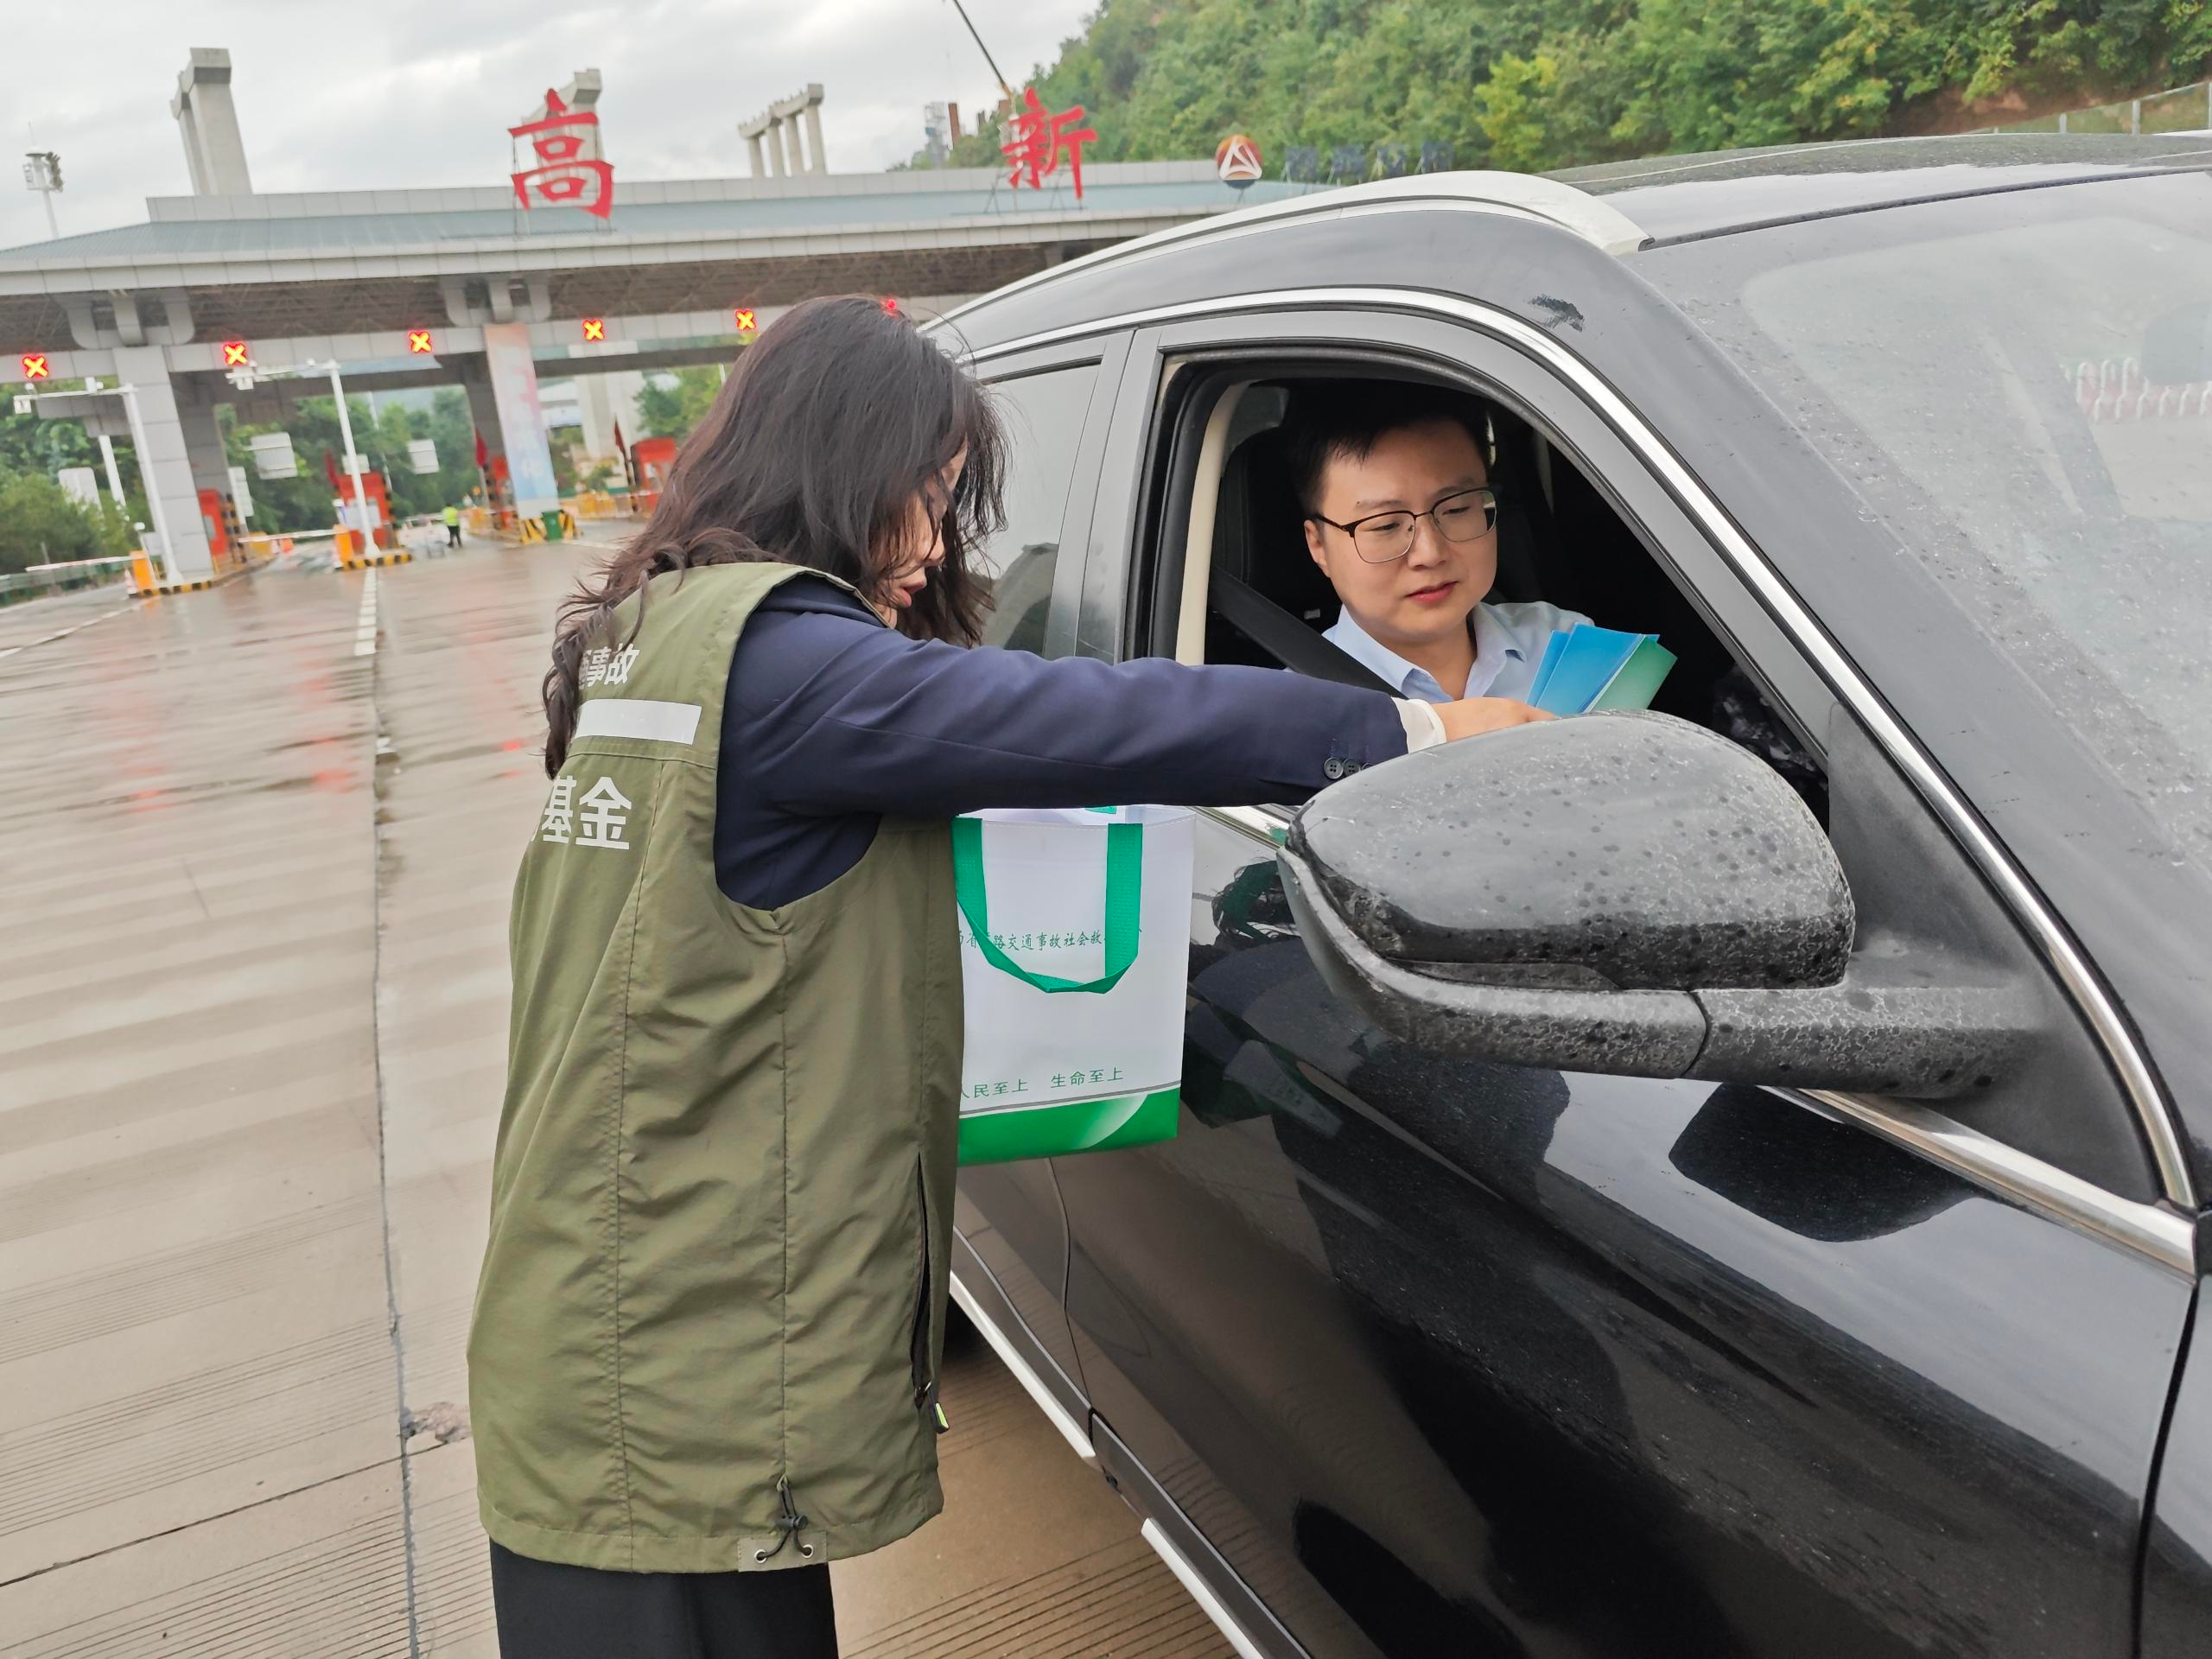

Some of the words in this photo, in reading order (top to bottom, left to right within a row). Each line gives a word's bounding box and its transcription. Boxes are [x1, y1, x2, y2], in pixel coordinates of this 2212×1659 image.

[507, 88, 614, 219] 高
[1001, 87, 1098, 200] 新
[531, 774, 632, 849] 基金
[1050, 1066, 1124, 1089] 生命至上
